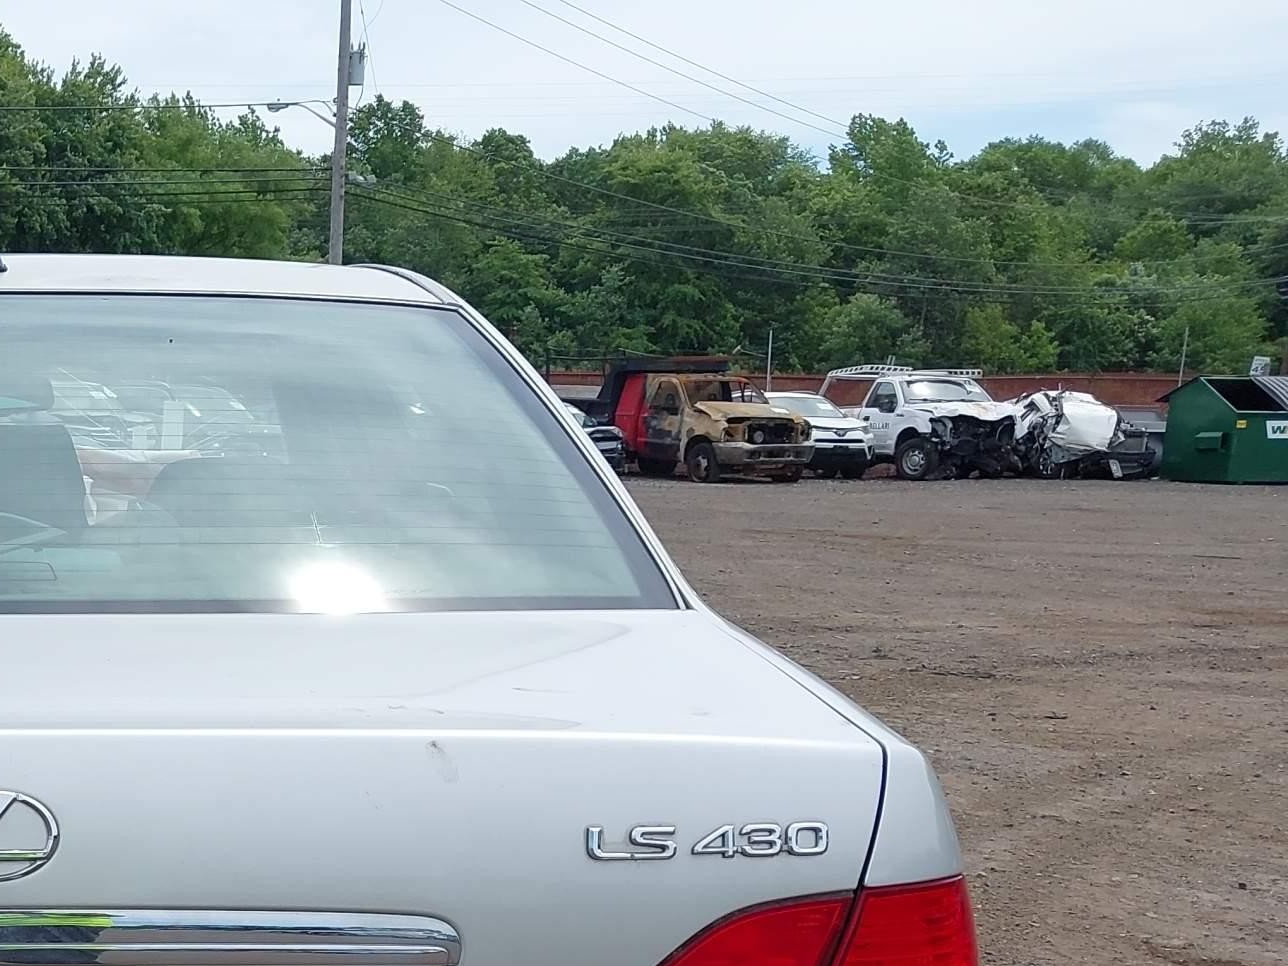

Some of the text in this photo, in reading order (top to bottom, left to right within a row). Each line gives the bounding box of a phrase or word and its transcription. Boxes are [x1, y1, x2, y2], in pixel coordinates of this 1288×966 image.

[1271, 425, 1288, 435] W
[586, 820, 829, 860] LS 430
